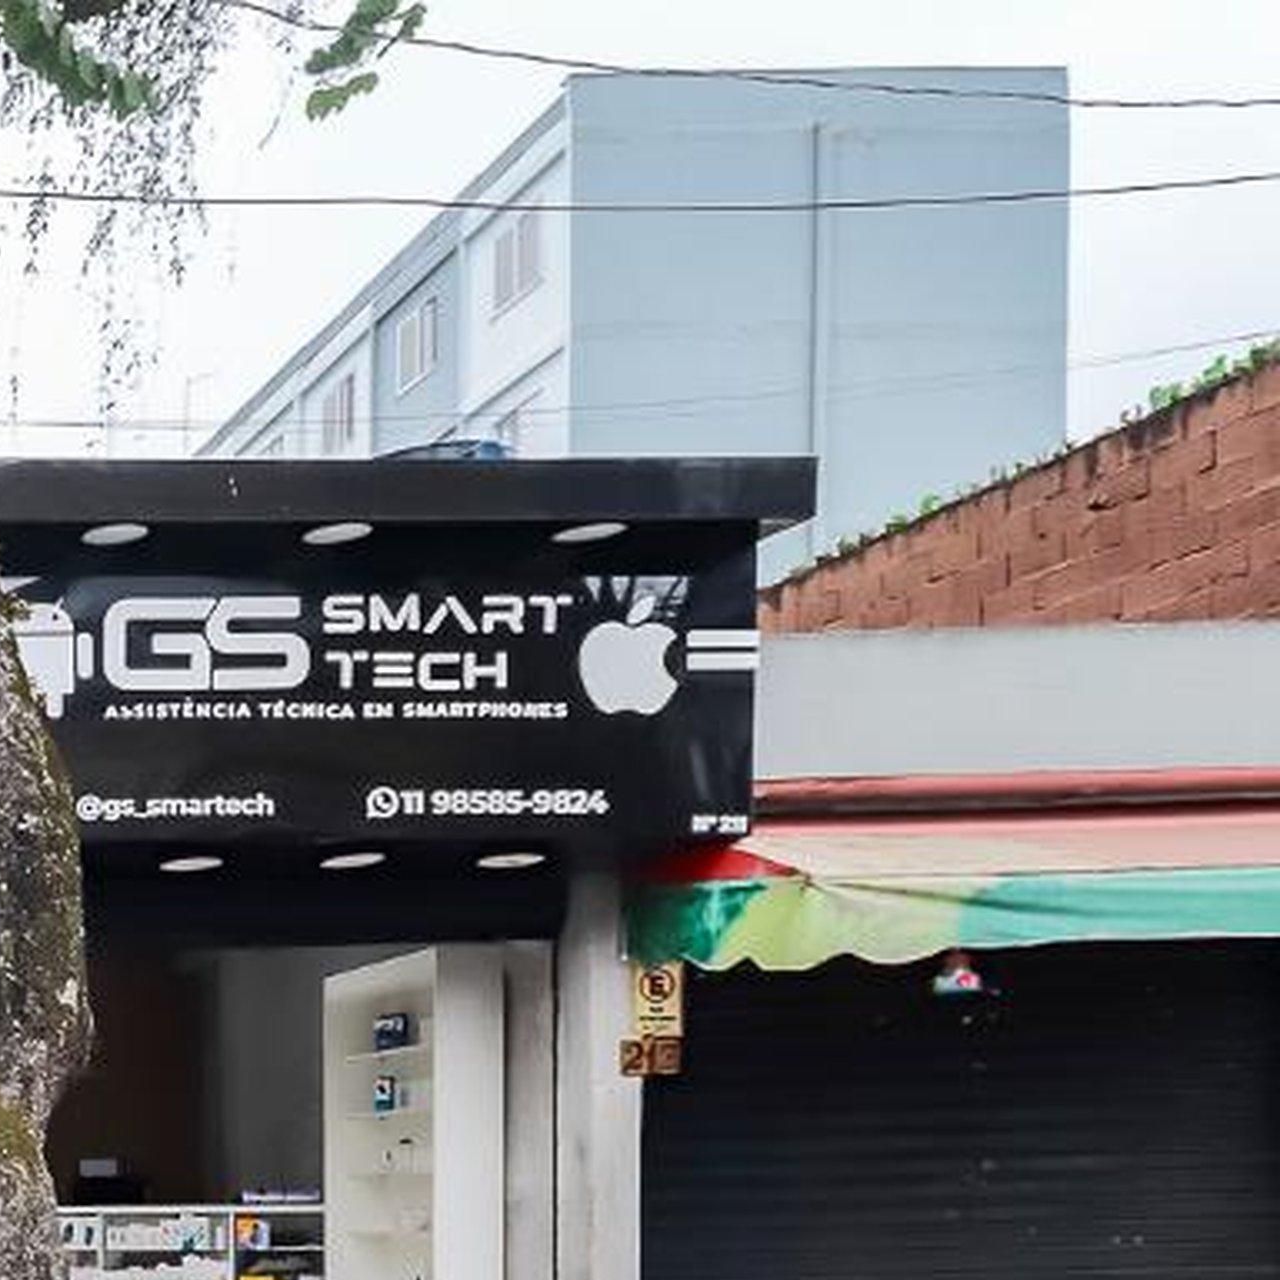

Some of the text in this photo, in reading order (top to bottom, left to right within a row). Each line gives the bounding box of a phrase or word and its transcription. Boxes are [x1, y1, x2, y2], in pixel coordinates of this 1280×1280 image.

[323, 593, 573, 635] SMART
[103, 596, 310, 690] GS
[325, 651, 508, 691] TECH
[103, 697, 569, 719] ASSISTÊNCIA TÉCNICA EM SMARTPHONES
[76, 792, 274, 821] @gs_smartech
[400, 789, 610, 815] 11 98585-9824
